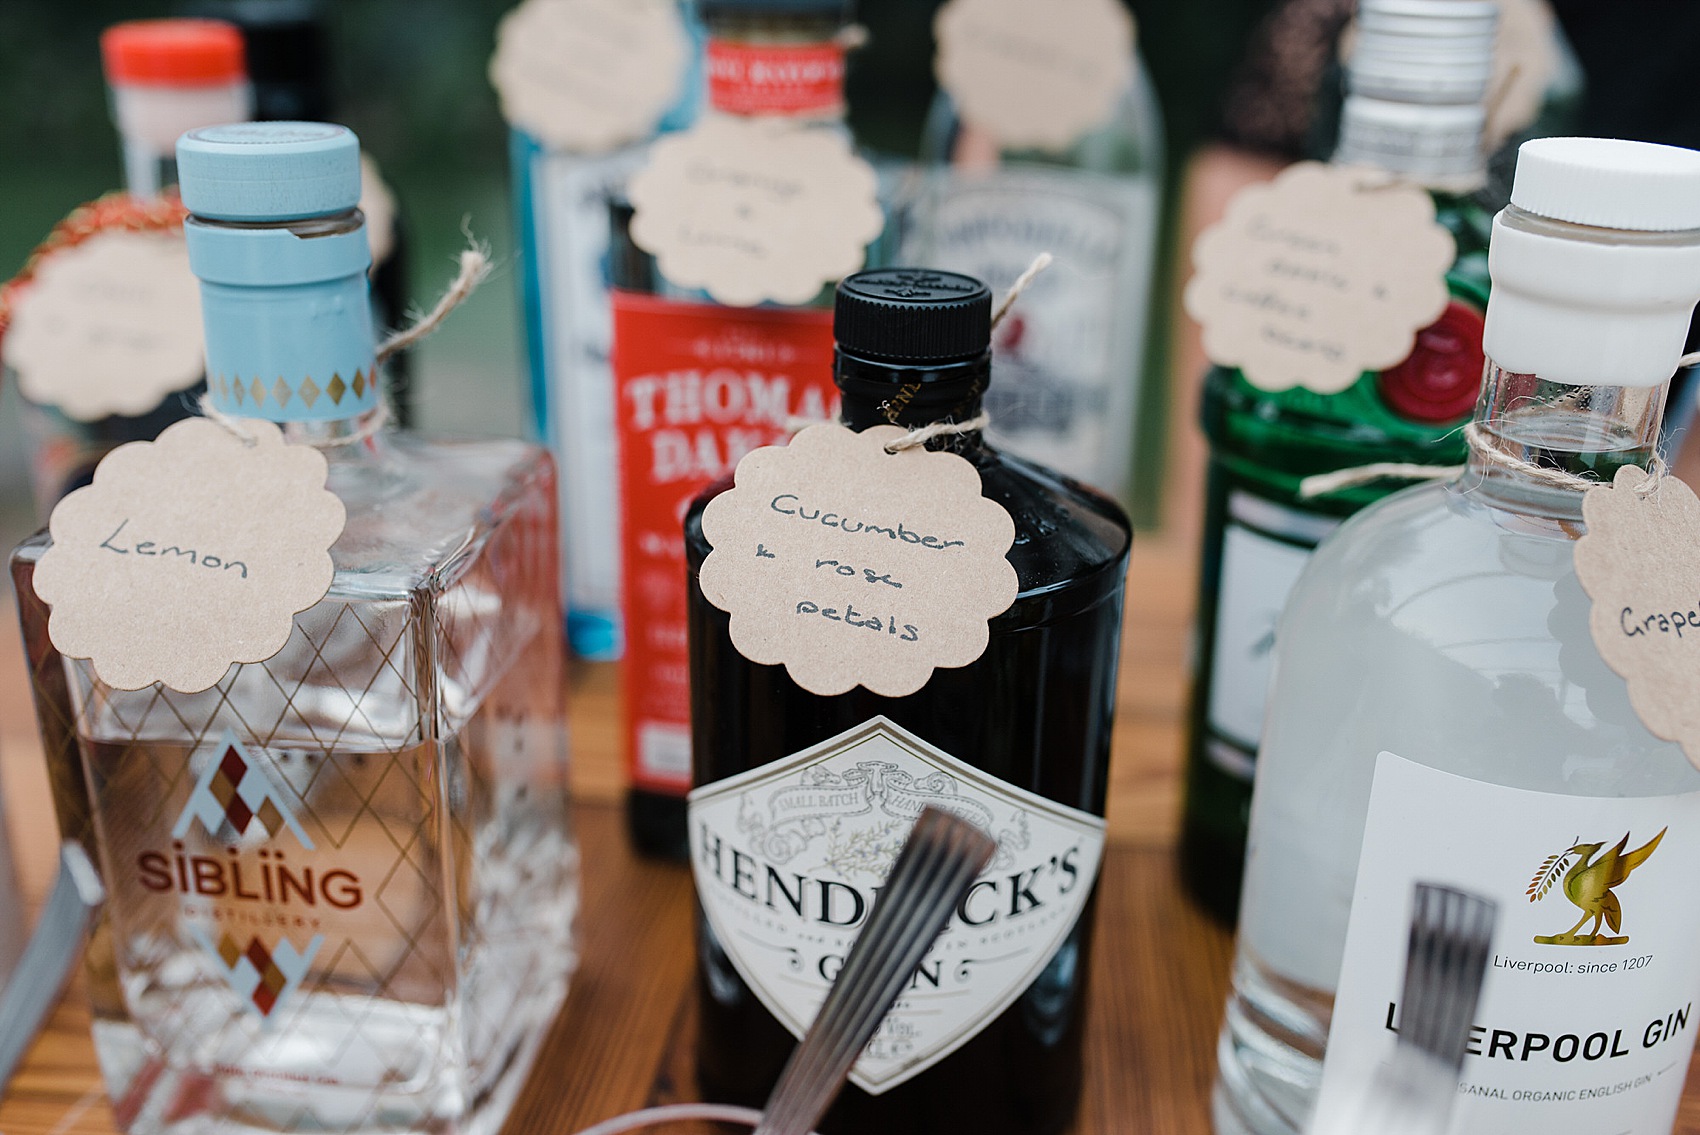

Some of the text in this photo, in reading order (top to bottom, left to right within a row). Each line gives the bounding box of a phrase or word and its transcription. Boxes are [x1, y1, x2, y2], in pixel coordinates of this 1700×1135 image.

[770, 494, 965, 550] Cucumber
[101, 519, 248, 579] Lemon
[815, 559, 903, 589] rose
[796, 601, 919, 642] petals
[1620, 601, 1700, 639] Grape
[700, 820, 1079, 927] HENDCK'S
[818, 954, 942, 989] GN
[1493, 954, 1653, 975] Liverpool: since 1207
[1385, 1001, 1692, 1064] LERPOOL GIN
[1512, 1089, 1576, 1102] ORGANIC
[1578, 1080, 1633, 1100] ENGLISH
[1633, 1074, 1653, 1089] GIN
